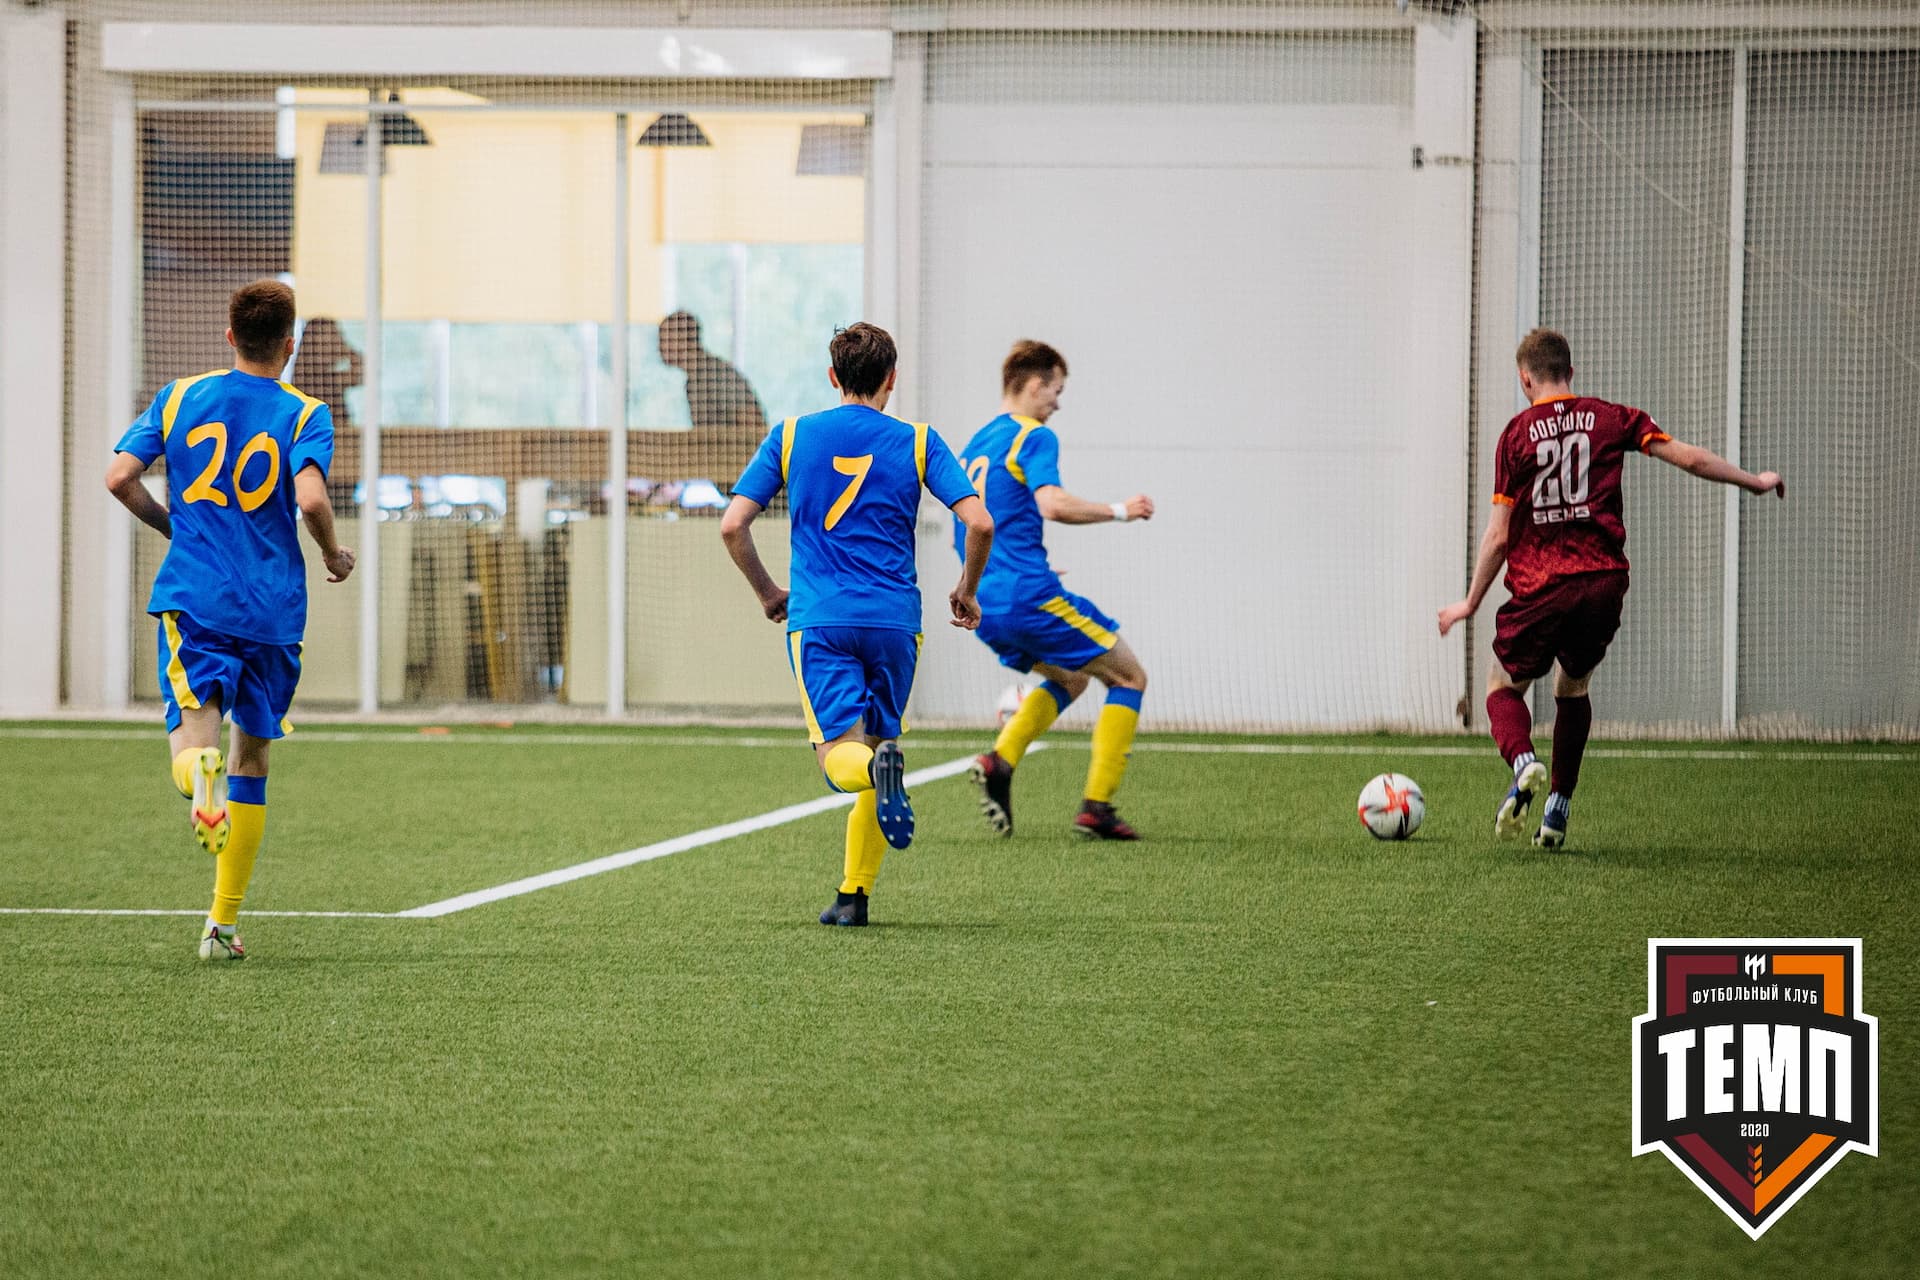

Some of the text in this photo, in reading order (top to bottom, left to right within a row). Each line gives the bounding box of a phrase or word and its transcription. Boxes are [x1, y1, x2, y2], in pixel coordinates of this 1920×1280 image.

[182, 421, 280, 512] 20
[824, 454, 873, 531] 7
[959, 455, 990, 503] 9
[1532, 432, 1590, 508] 20
